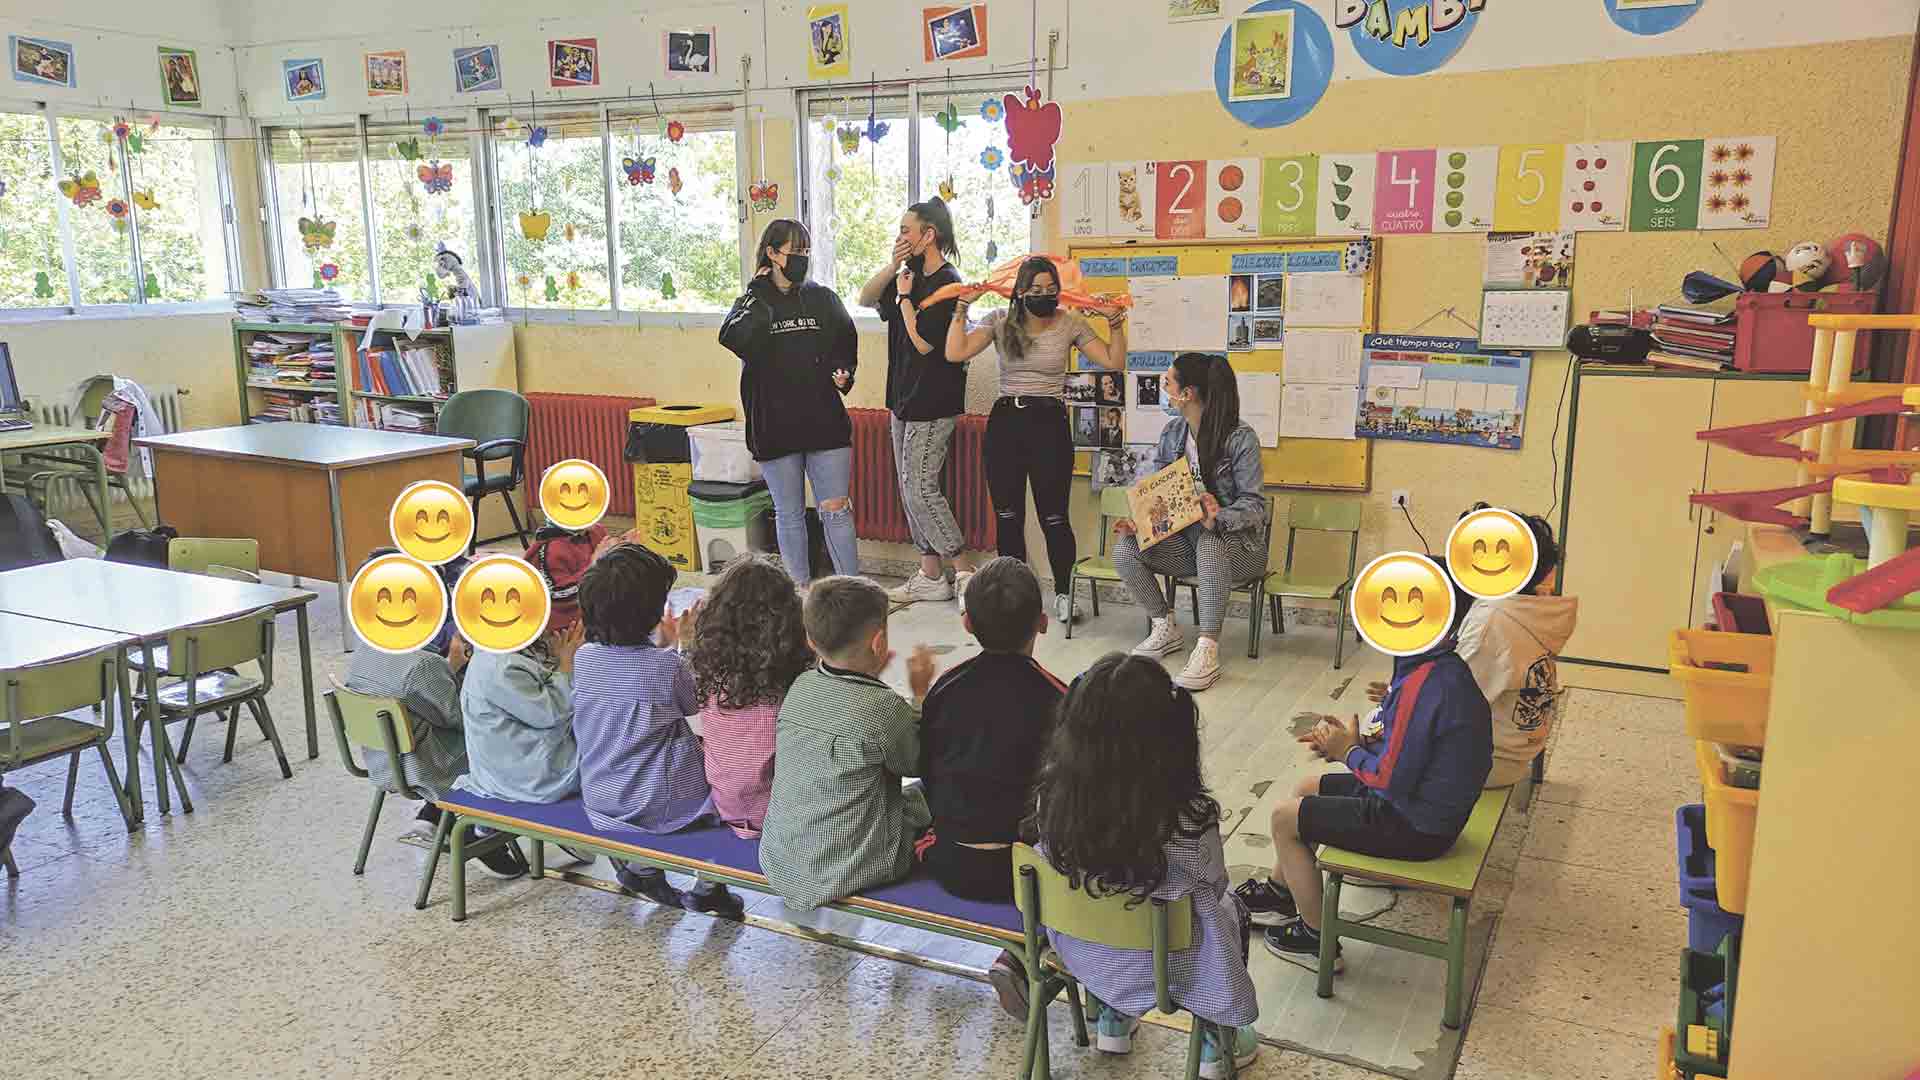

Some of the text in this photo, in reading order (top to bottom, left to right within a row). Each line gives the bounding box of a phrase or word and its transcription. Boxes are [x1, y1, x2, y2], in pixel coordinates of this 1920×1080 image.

[1334, 0, 1486, 48] BAMB
[1072, 166, 1091, 217] 1
[1168, 163, 1195, 214] 2
[1276, 160, 1304, 212] 3
[1391, 154, 1421, 209] 4
[1516, 149, 1546, 206] 5
[1648, 144, 1686, 203] 6
[1073, 225, 1093, 235] UNO
[1381, 219, 1425, 231] CUATRO
[1649, 216, 1676, 229] SEIS
[1395, 337, 1428, 349] tiempo
[1430, 340, 1461, 350] hace?
